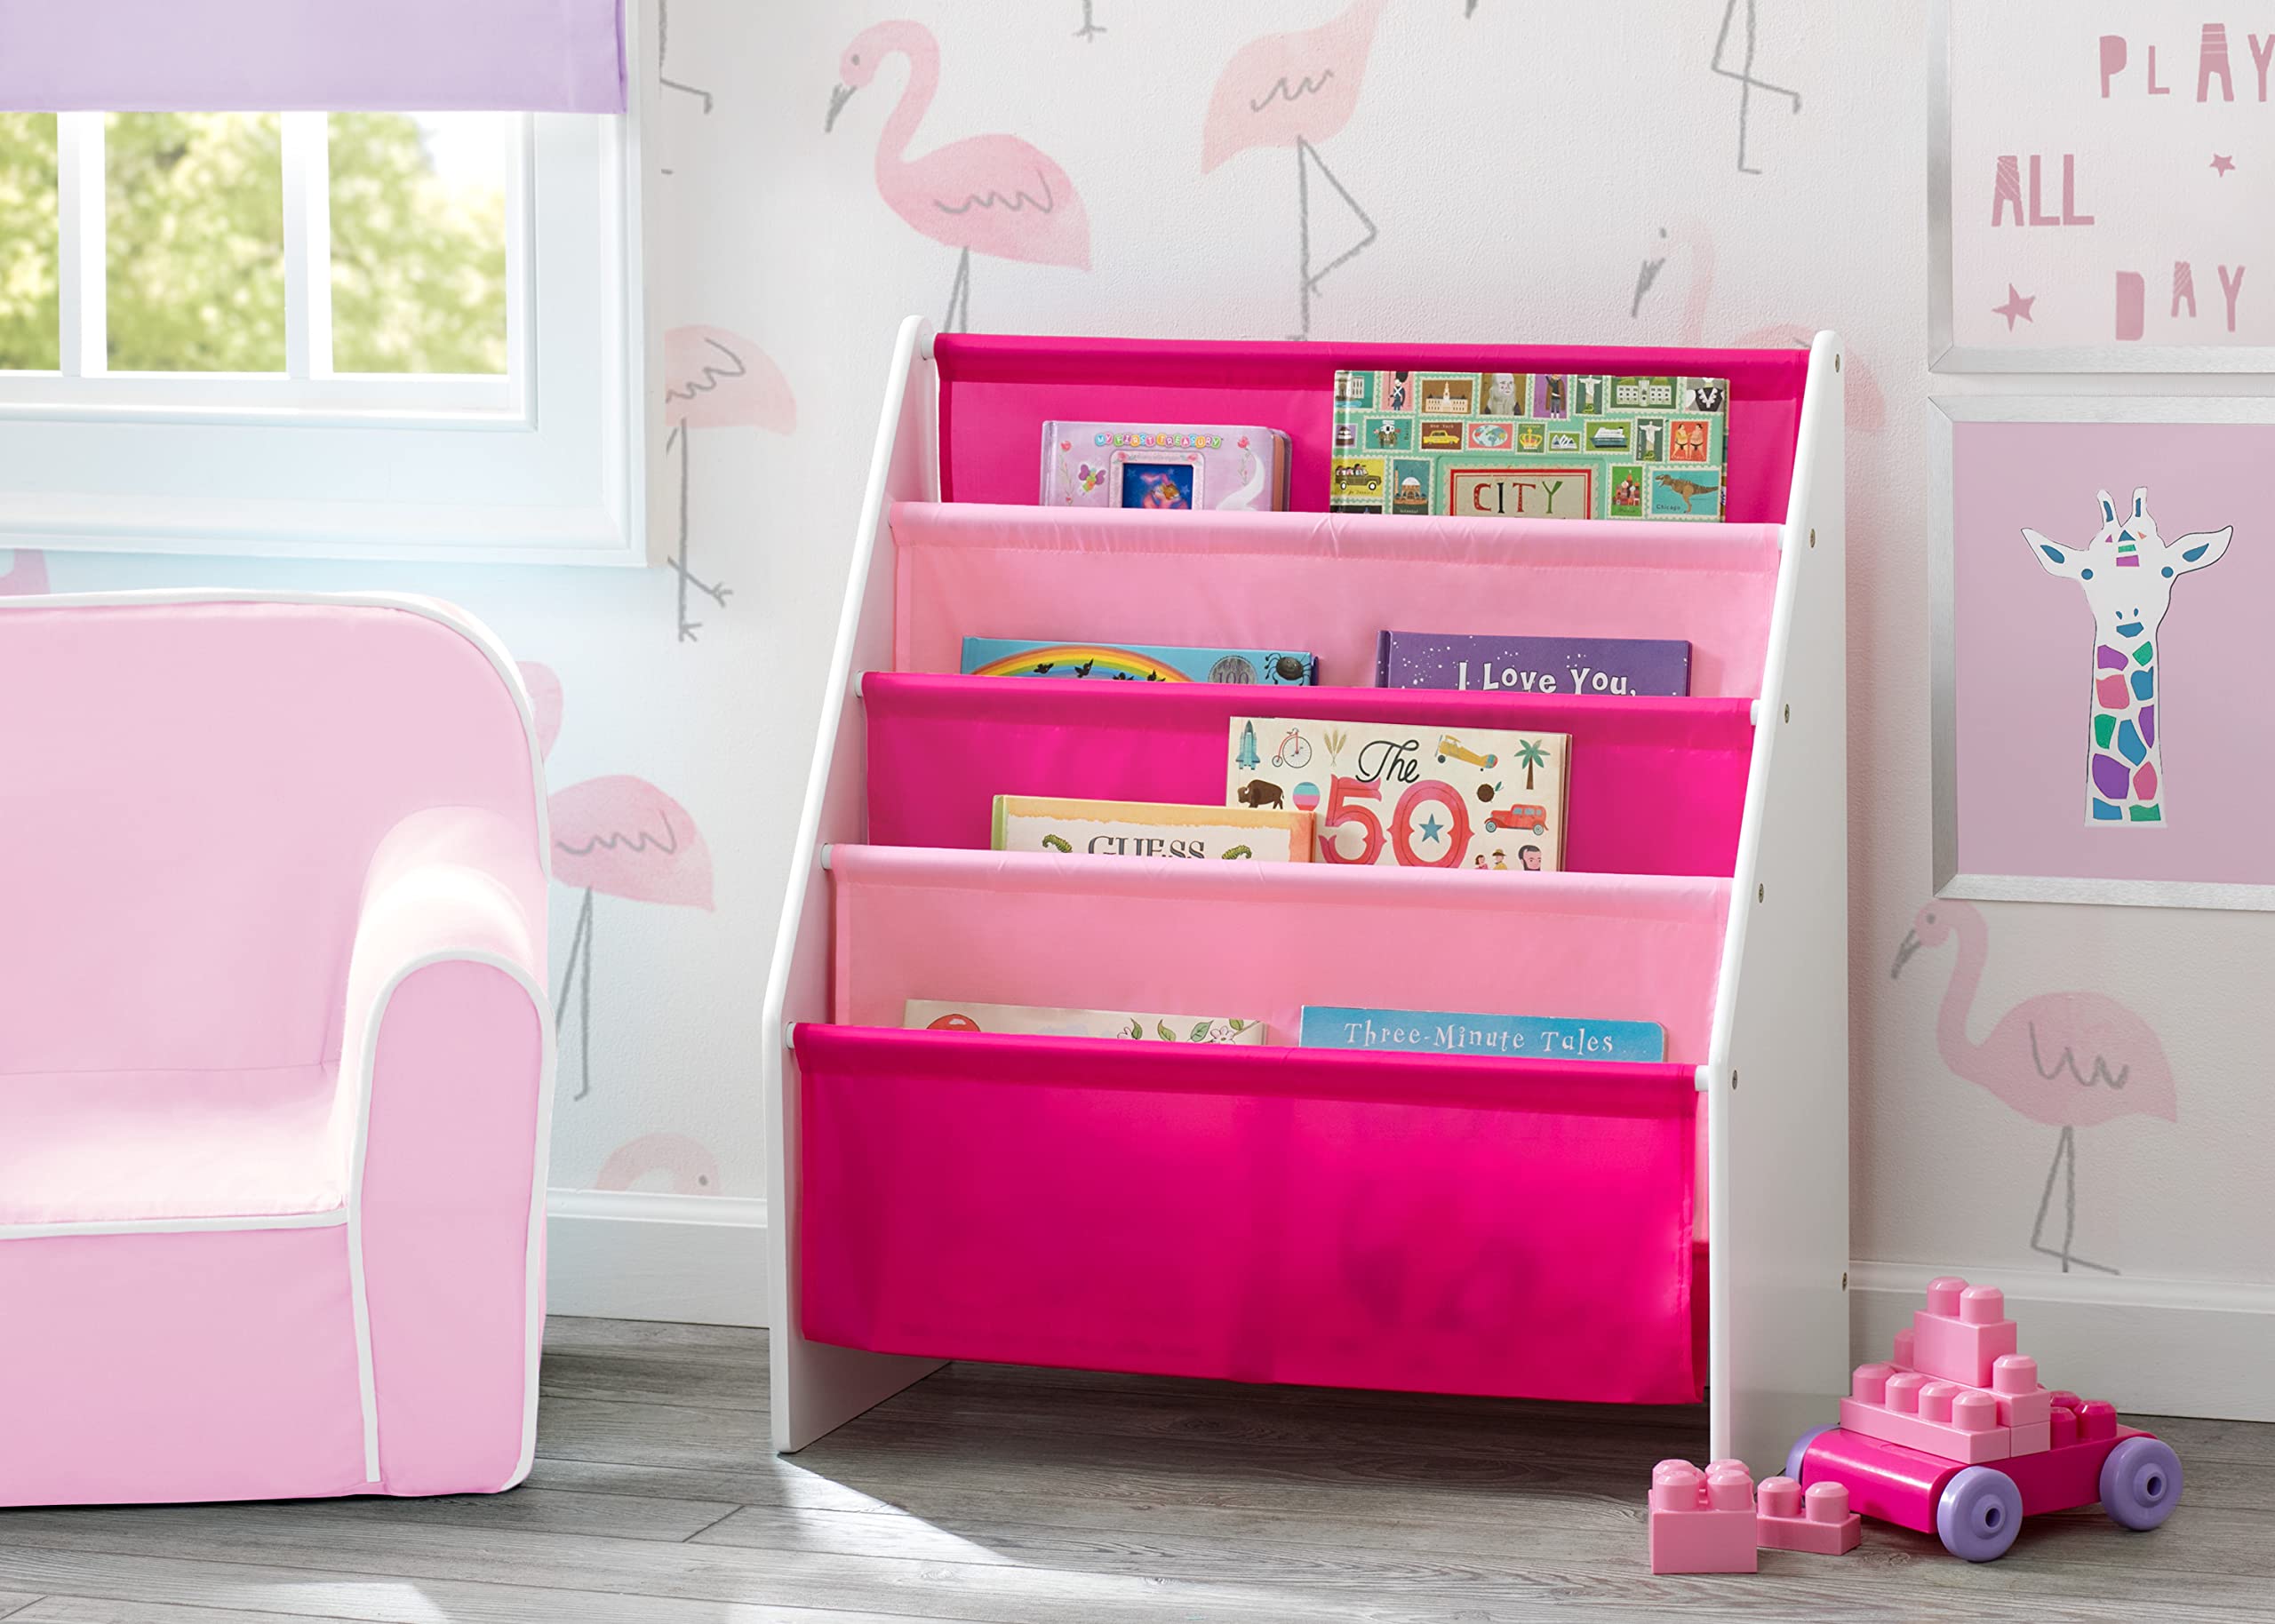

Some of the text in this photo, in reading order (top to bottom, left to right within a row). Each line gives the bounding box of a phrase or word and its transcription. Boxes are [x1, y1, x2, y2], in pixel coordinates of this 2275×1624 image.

[2099, 23, 2275, 102] PLAY
[1992, 155, 2095, 227] ALL
[2115, 261, 2246, 341] DAY
[1096, 433, 1222, 449] MY FIRST TREASURY
[1473, 481, 1563, 514] CITY
[1457, 661, 1637, 697] I Love You,
[1355, 739, 1420, 784] The
[1318, 774, 1475, 869] 50
[1088, 835, 1205, 859] GUESS
[1344, 1019, 1615, 1055] Three-Minute Tales
